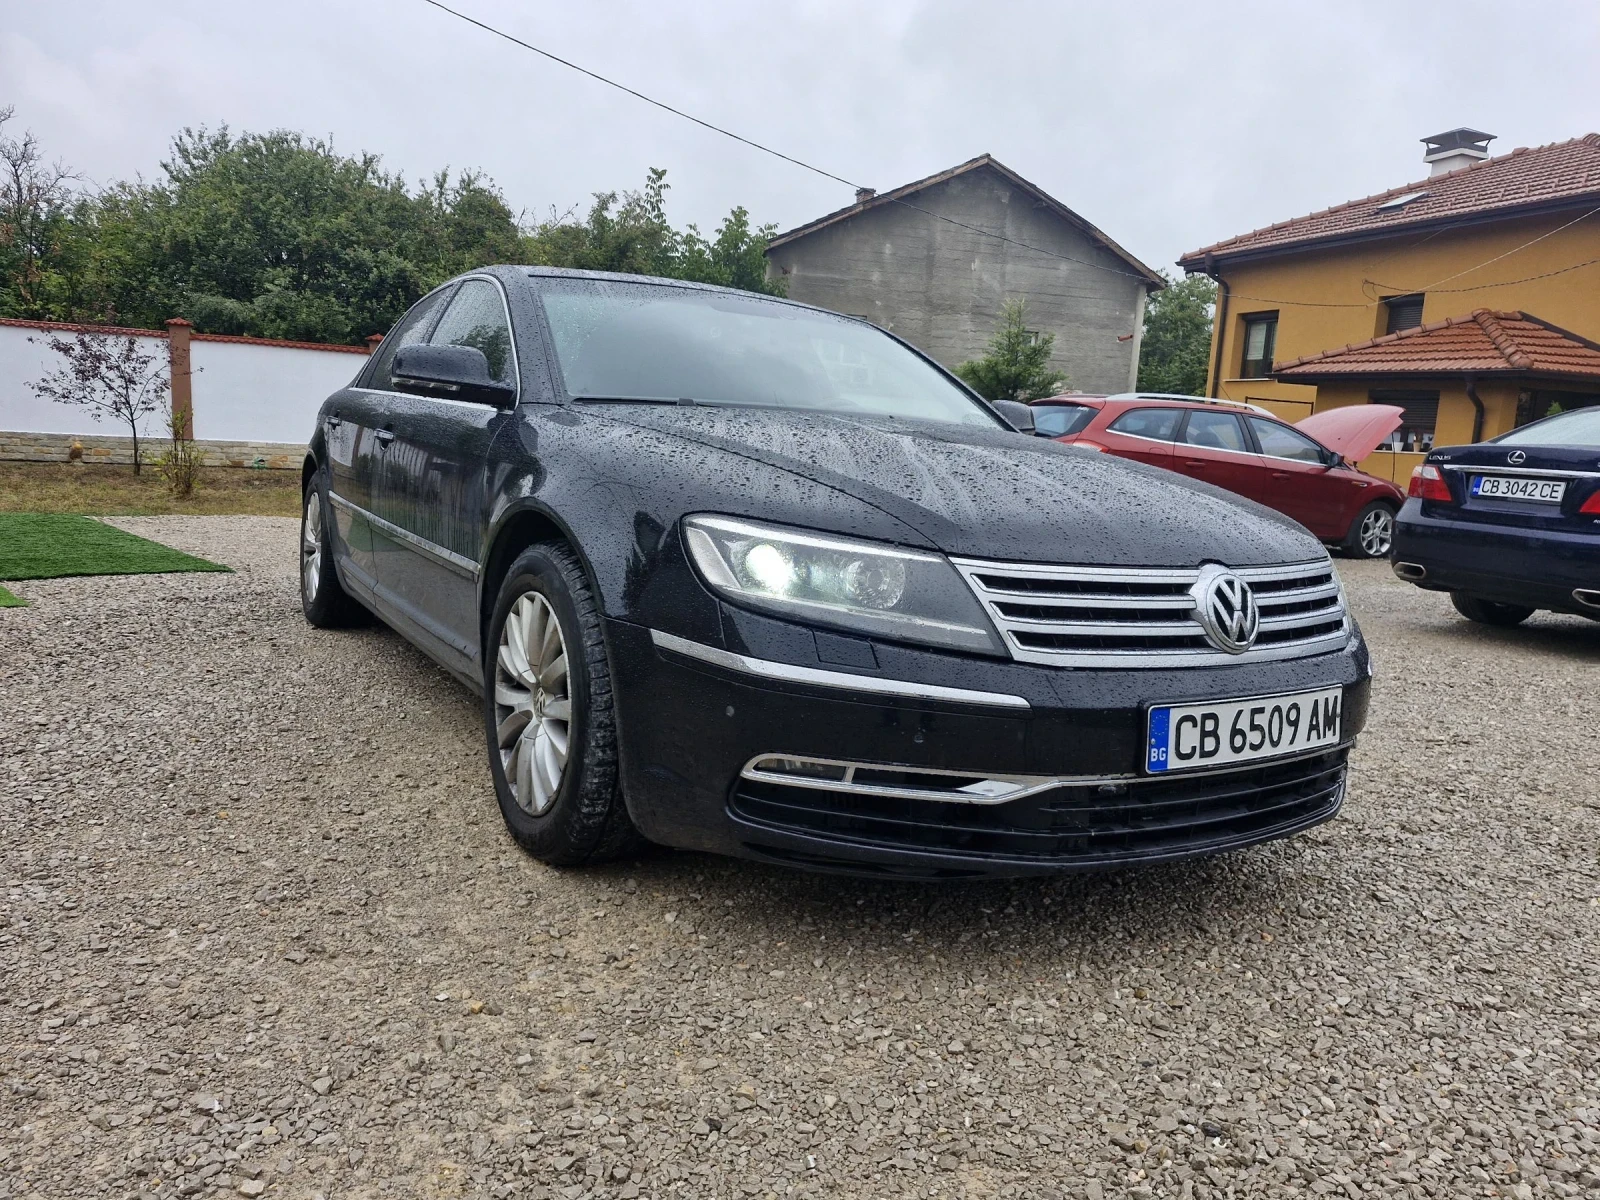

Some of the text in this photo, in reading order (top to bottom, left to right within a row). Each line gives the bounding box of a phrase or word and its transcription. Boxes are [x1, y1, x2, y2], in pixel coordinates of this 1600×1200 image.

[1481, 478, 1562, 499] CB 3042 CE
[1210, 576, 1254, 645] VW
[1174, 694, 1339, 761] CB 6509 AM
[1150, 747, 1167, 763] BG
